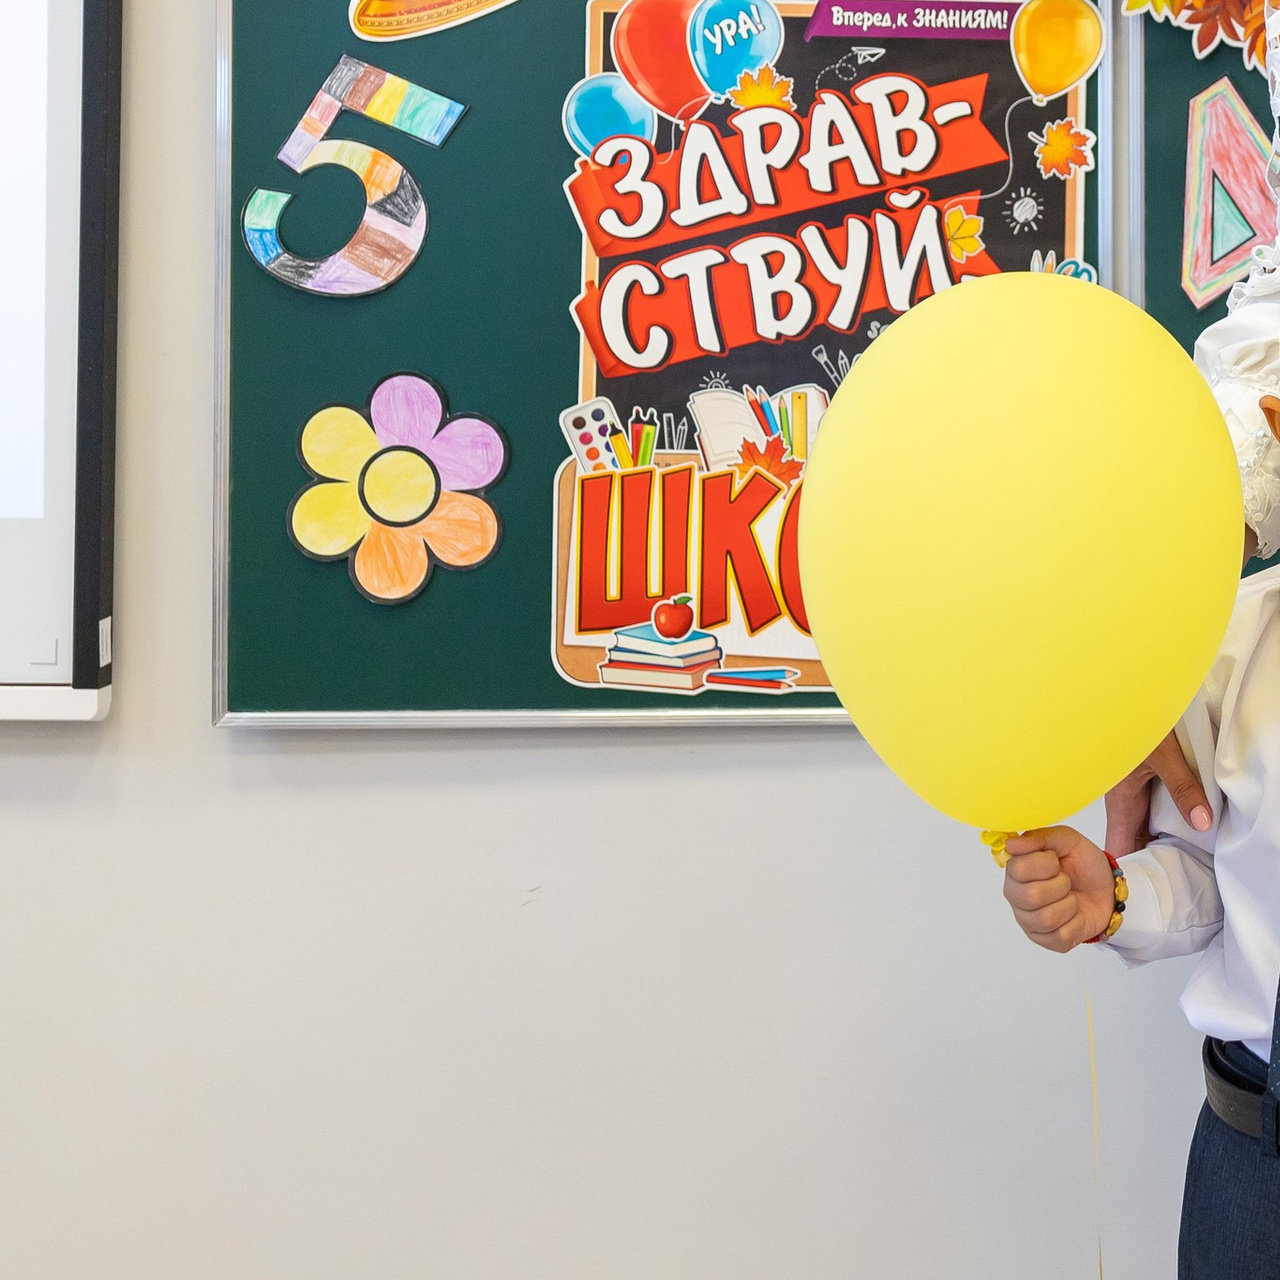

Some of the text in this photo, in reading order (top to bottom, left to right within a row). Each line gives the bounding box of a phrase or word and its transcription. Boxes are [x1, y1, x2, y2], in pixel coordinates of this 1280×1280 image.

[703, 3, 766, 55] УРА!
[912, 7, 1009, 30] ЗНАНИЯМ!
[598, 75, 972, 239] ЗДРАВ-
